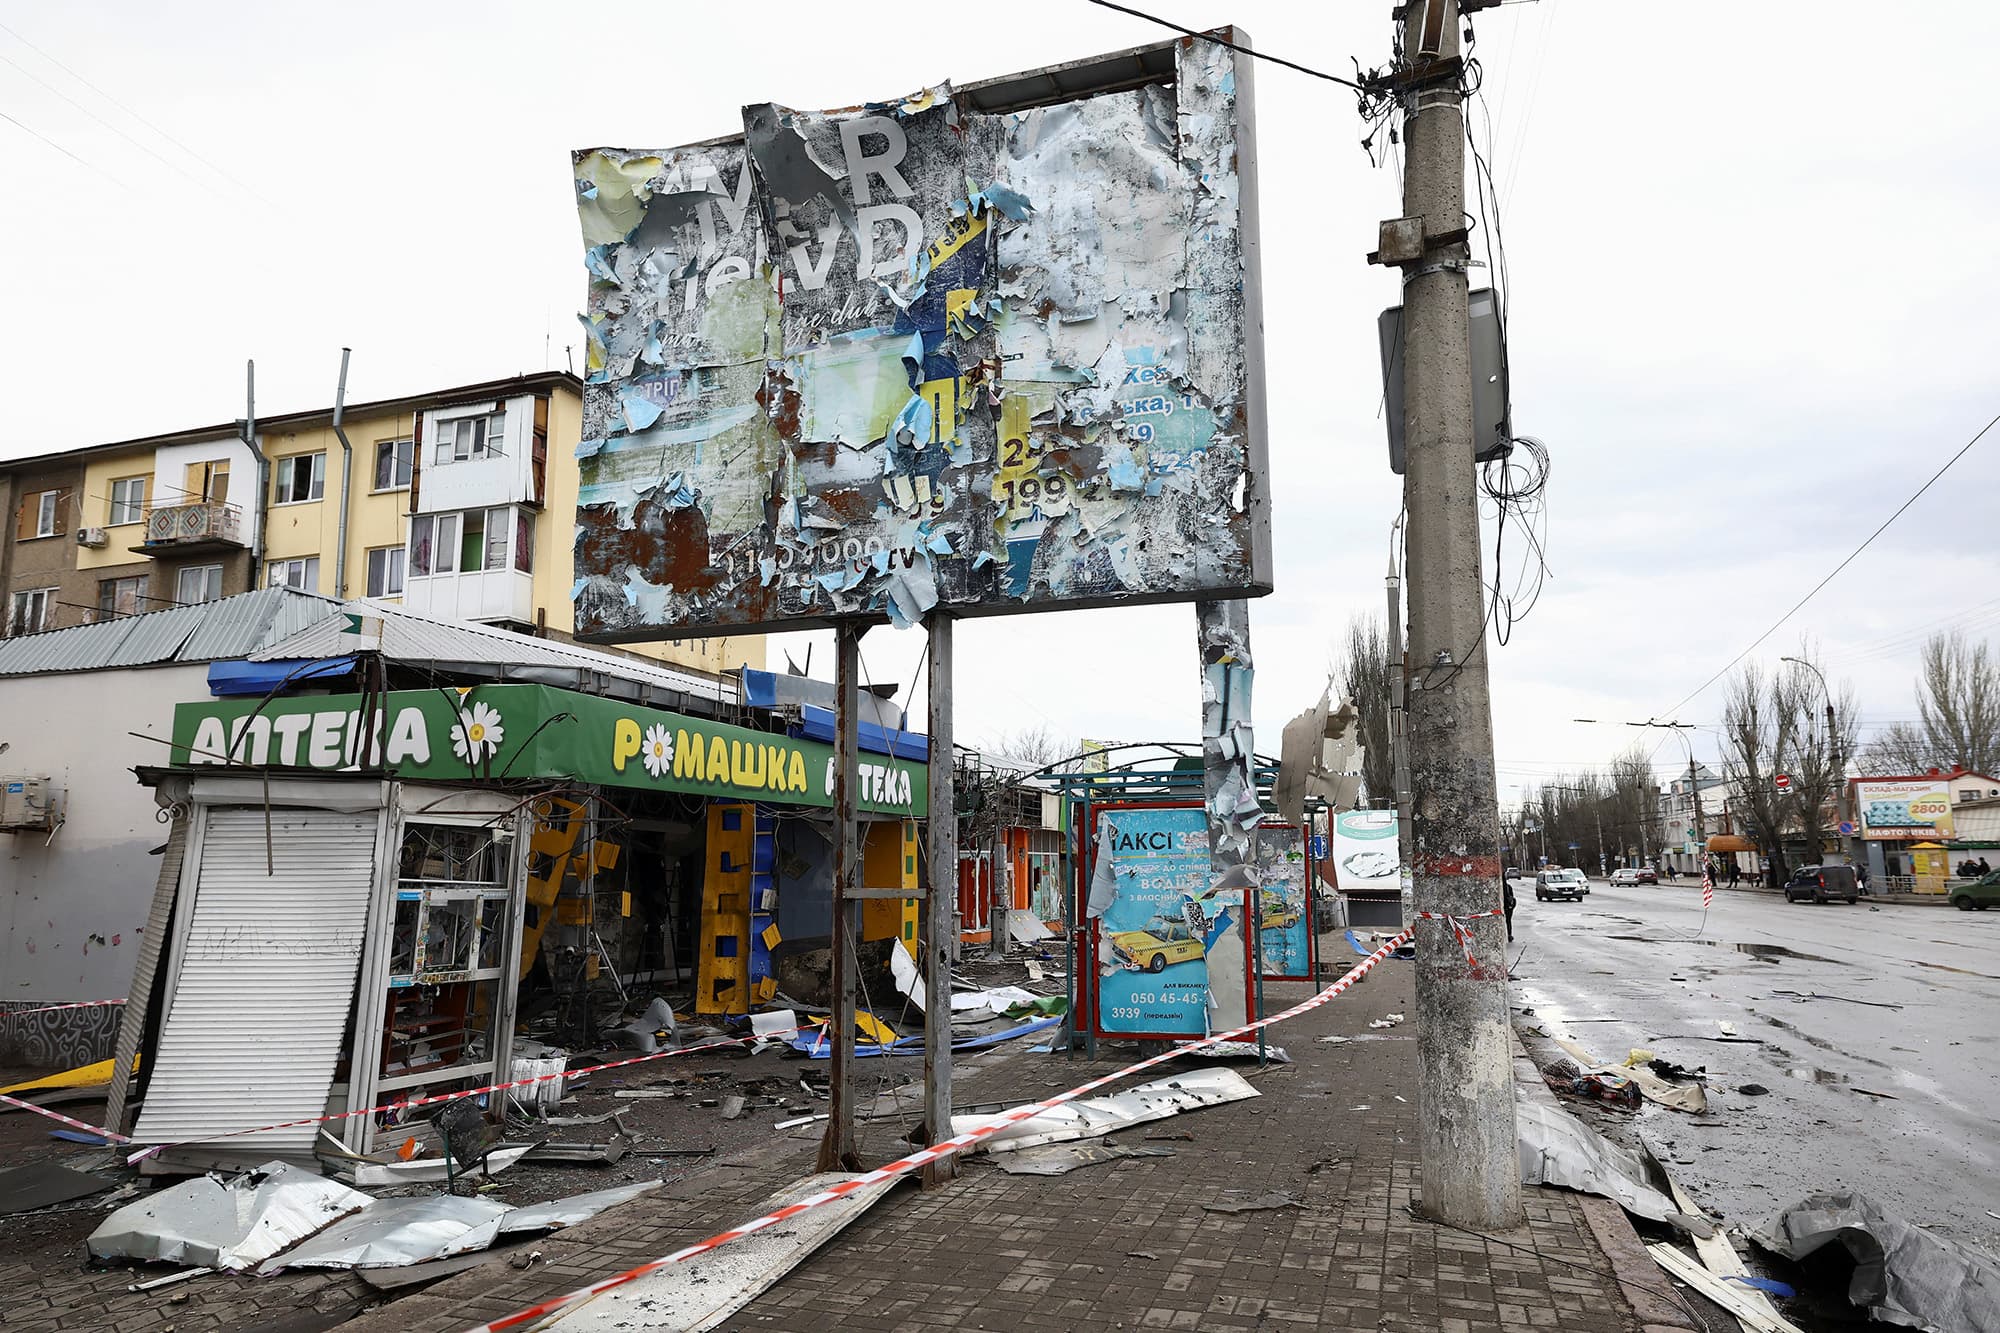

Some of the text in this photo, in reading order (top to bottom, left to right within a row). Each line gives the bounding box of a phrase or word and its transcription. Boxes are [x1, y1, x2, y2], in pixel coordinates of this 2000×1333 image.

[825, 755, 913, 807] АТЕКА
[1911, 804, 1947, 814] 2800
[1131, 992, 1155, 1004] 050
[1112, 1007, 1140, 1019] 3939
